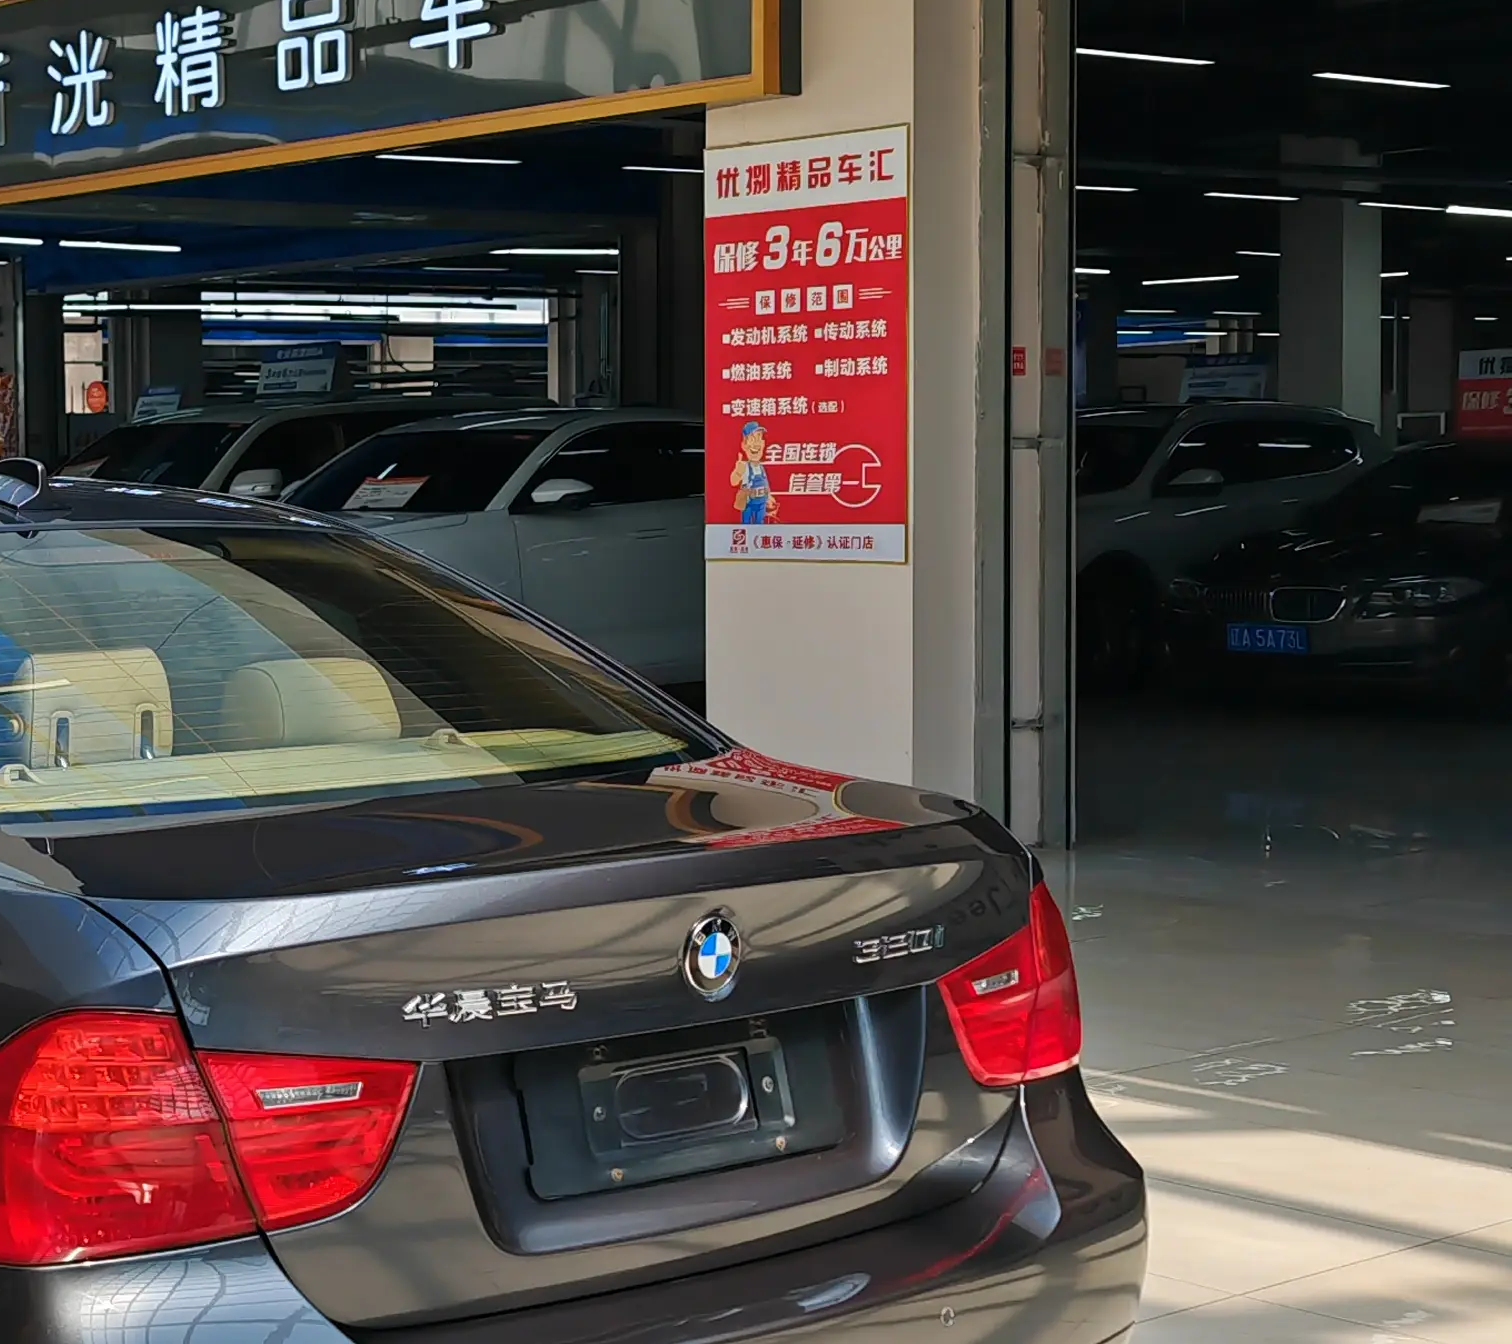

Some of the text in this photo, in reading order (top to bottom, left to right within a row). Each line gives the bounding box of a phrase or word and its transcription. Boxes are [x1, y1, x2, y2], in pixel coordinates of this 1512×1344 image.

[716, 148, 895, 199] 优捌精品车汇
[713, 221, 903, 274] 保修3年6万公里
[759, 288, 849, 310] 保修范围
[730, 323, 808, 346] 发动机系统
[823, 319, 887, 341] 传动系统
[730, 361, 792, 382] 燃油系统
[824, 356, 888, 378] 制动系统
[765, 442, 837, 463] 全国连锁
[852, 924, 945, 964] 320i
[401, 979, 579, 1029] 华晨宝马
